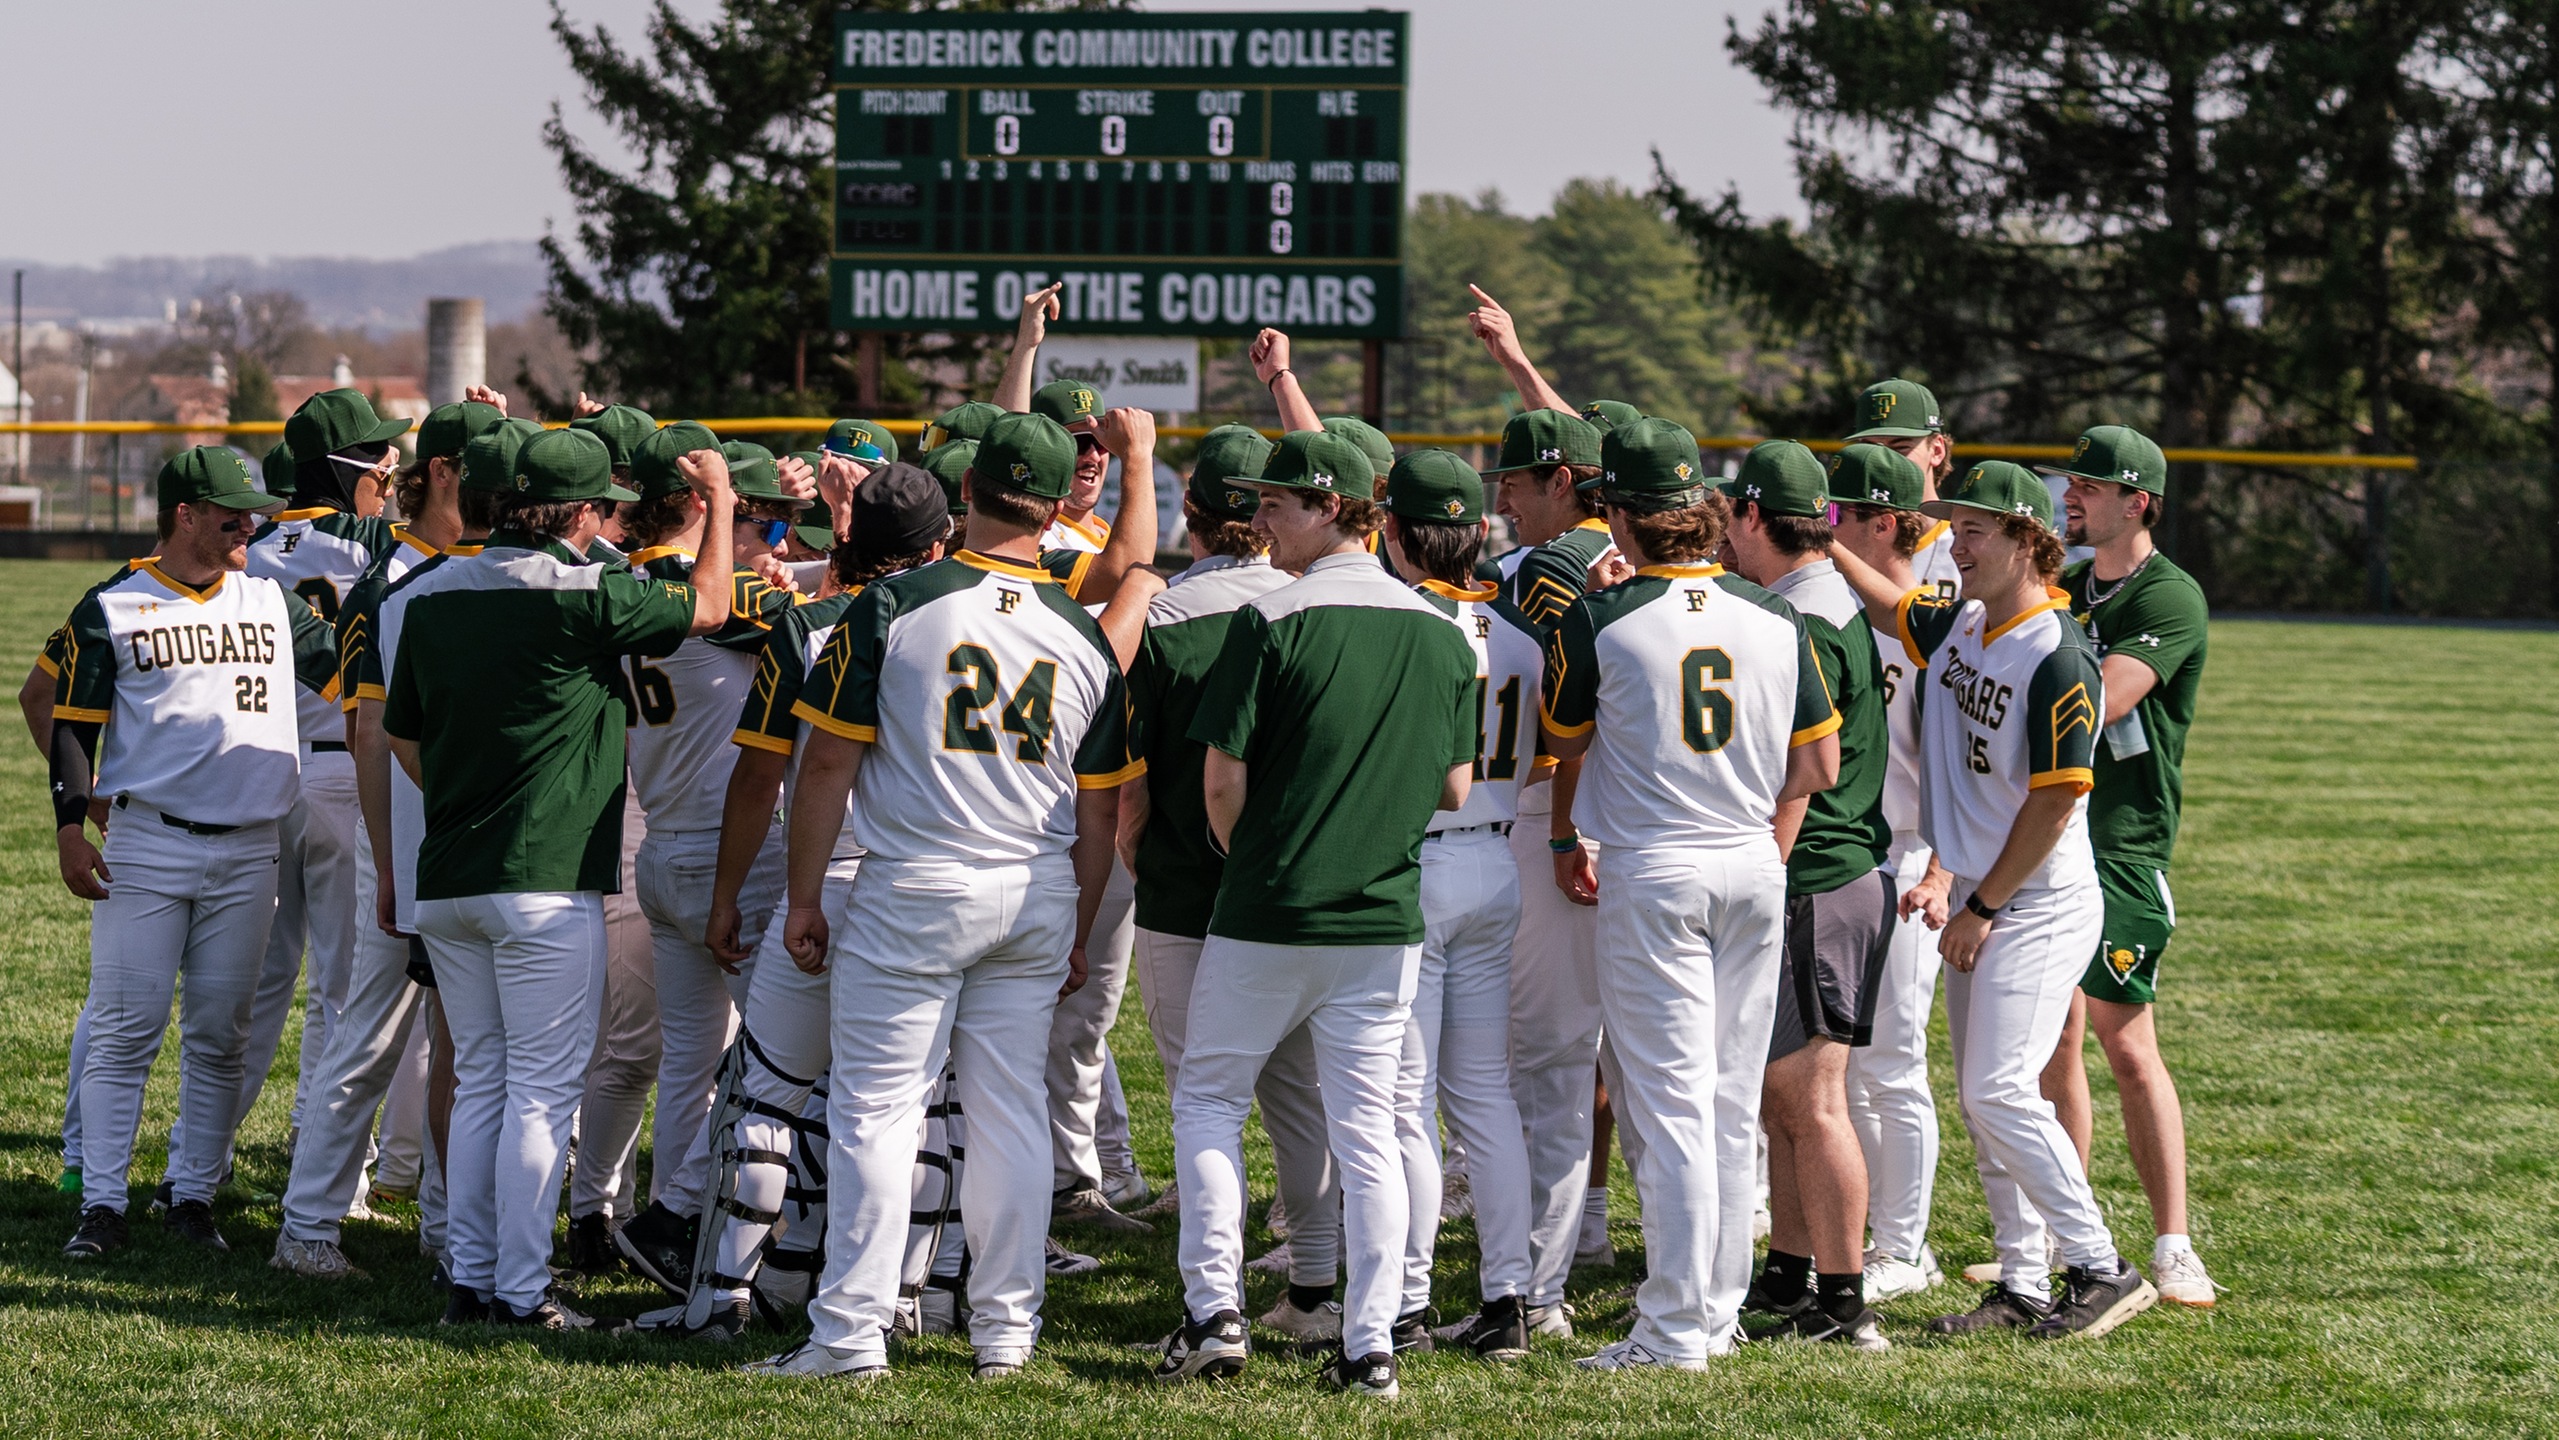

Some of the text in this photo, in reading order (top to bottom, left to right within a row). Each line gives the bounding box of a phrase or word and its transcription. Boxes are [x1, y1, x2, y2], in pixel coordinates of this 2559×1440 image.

[843, 29, 1395, 68] FREDERICK COMMUNITY COLLEGE
[861, 90, 948, 115] PITCH COUNT
[979, 90, 1035, 115] BALL
[1076, 90, 1154, 116] STRIKE
[1197, 90, 1244, 115] OUT
[1317, 91, 1358, 117] H/E
[995, 115, 1020, 155] 0
[1101, 115, 1126, 156] 0
[1209, 115, 1234, 156] 0
[940, 160, 952, 180] 1
[965, 160, 980, 181] 2
[993, 160, 1007, 181] 3
[1028, 160, 1042, 181] 4
[1056, 160, 1071, 181] 5
[1084, 160, 1098, 181] 6
[1121, 161, 1134, 182] 7
[1148, 161, 1162, 182] 8
[1176, 161, 1190, 182] 9
[1208, 161, 1230, 182] 10
[1245, 161, 1296, 183] RUNS
[1311, 161, 1354, 183] HITS
[1270, 182, 1293, 216] 0
[1270, 220, 1292, 254] 0
[853, 269, 979, 319] HOME
[1061, 271, 1144, 322] THE
[1159, 272, 1376, 326] COUGARS
[1120, 358, 1188, 386] Smith
[995, 587, 1022, 614] F
[1684, 589, 1707, 612] F
[131, 622, 275, 673] COUGARS
[235, 675, 268, 713] 22
[942, 641, 1058, 766] 24
[1680, 645, 1734, 754] 6
